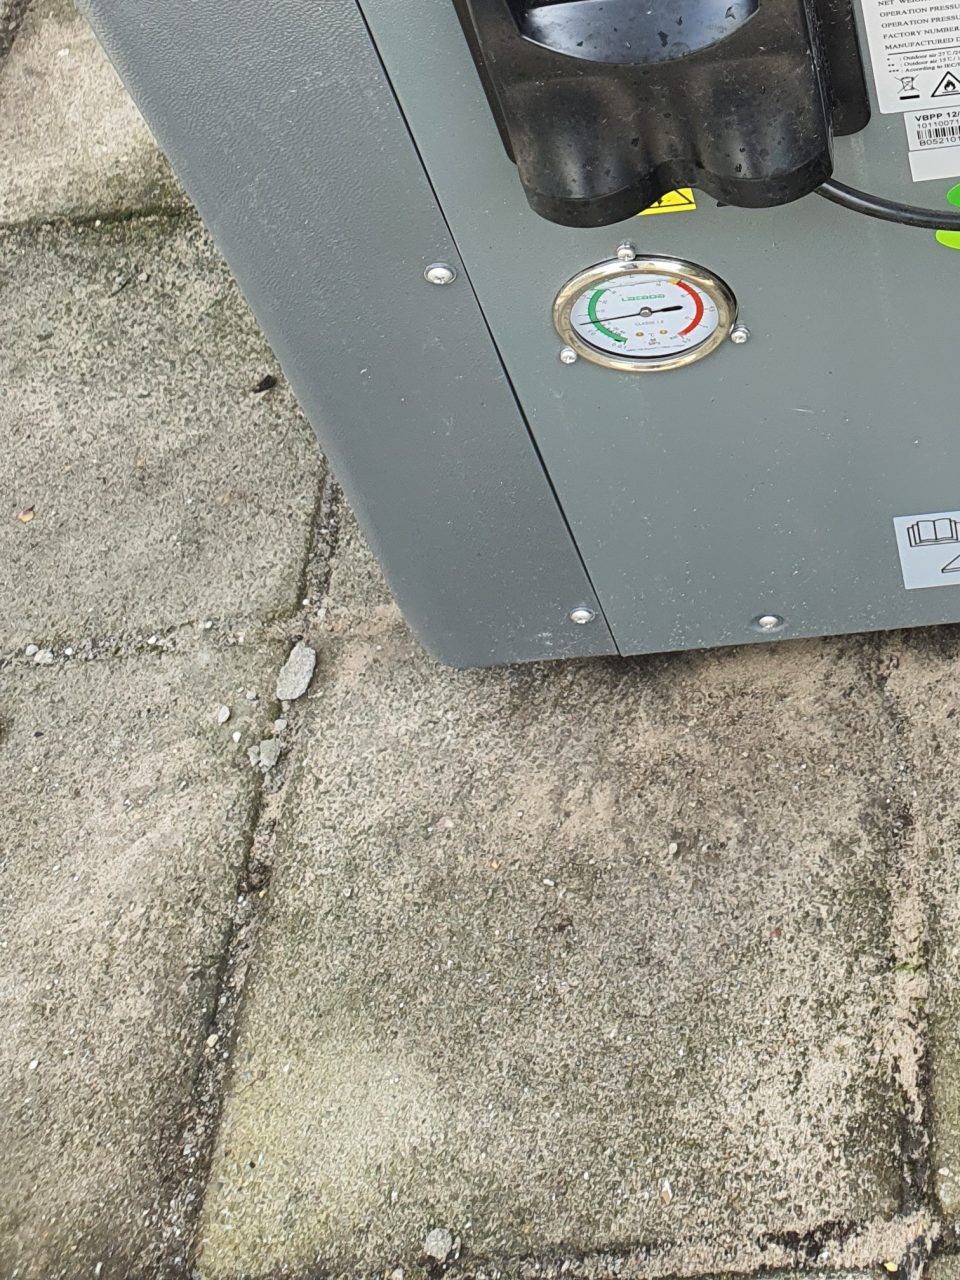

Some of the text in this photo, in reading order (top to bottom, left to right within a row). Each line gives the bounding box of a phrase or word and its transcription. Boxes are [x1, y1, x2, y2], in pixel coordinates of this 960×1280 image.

[880, 7, 927, 17] OPERATION
[881, 18, 929, 29] OPERATION
[883, 30, 921, 39] FACTORY
[924, 26, 960, 35] NUMBER:
[885, 38, 954, 50] MANUFACTURED
[915, 113, 942, 122] VBPP
[917, 119, 959, 129] 10110071
